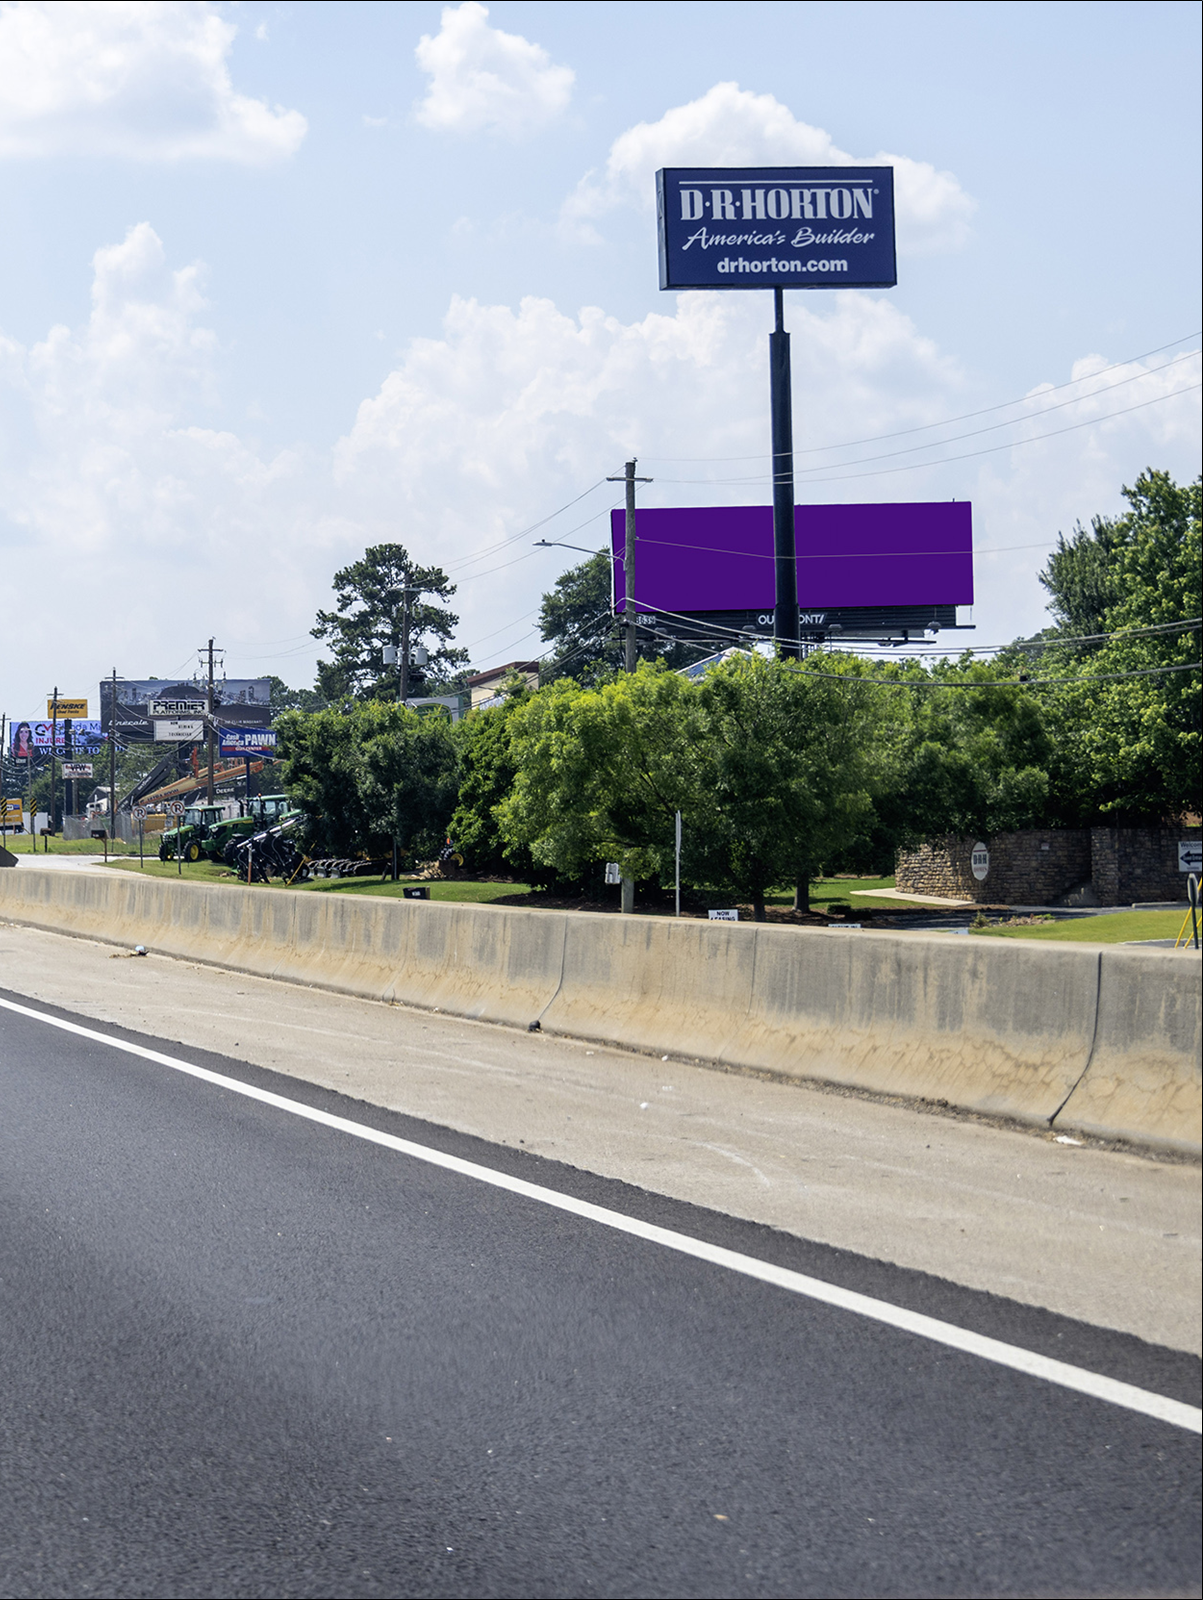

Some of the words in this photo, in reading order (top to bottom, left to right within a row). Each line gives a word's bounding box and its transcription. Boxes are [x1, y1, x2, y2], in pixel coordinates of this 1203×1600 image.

[682, 226, 786, 251] America's
[790, 226, 875, 248] Builder
[717, 257, 848, 273] drhorton.com
[758, 614, 825, 625] OUONT/
[244, 733, 276, 746] PAWN
